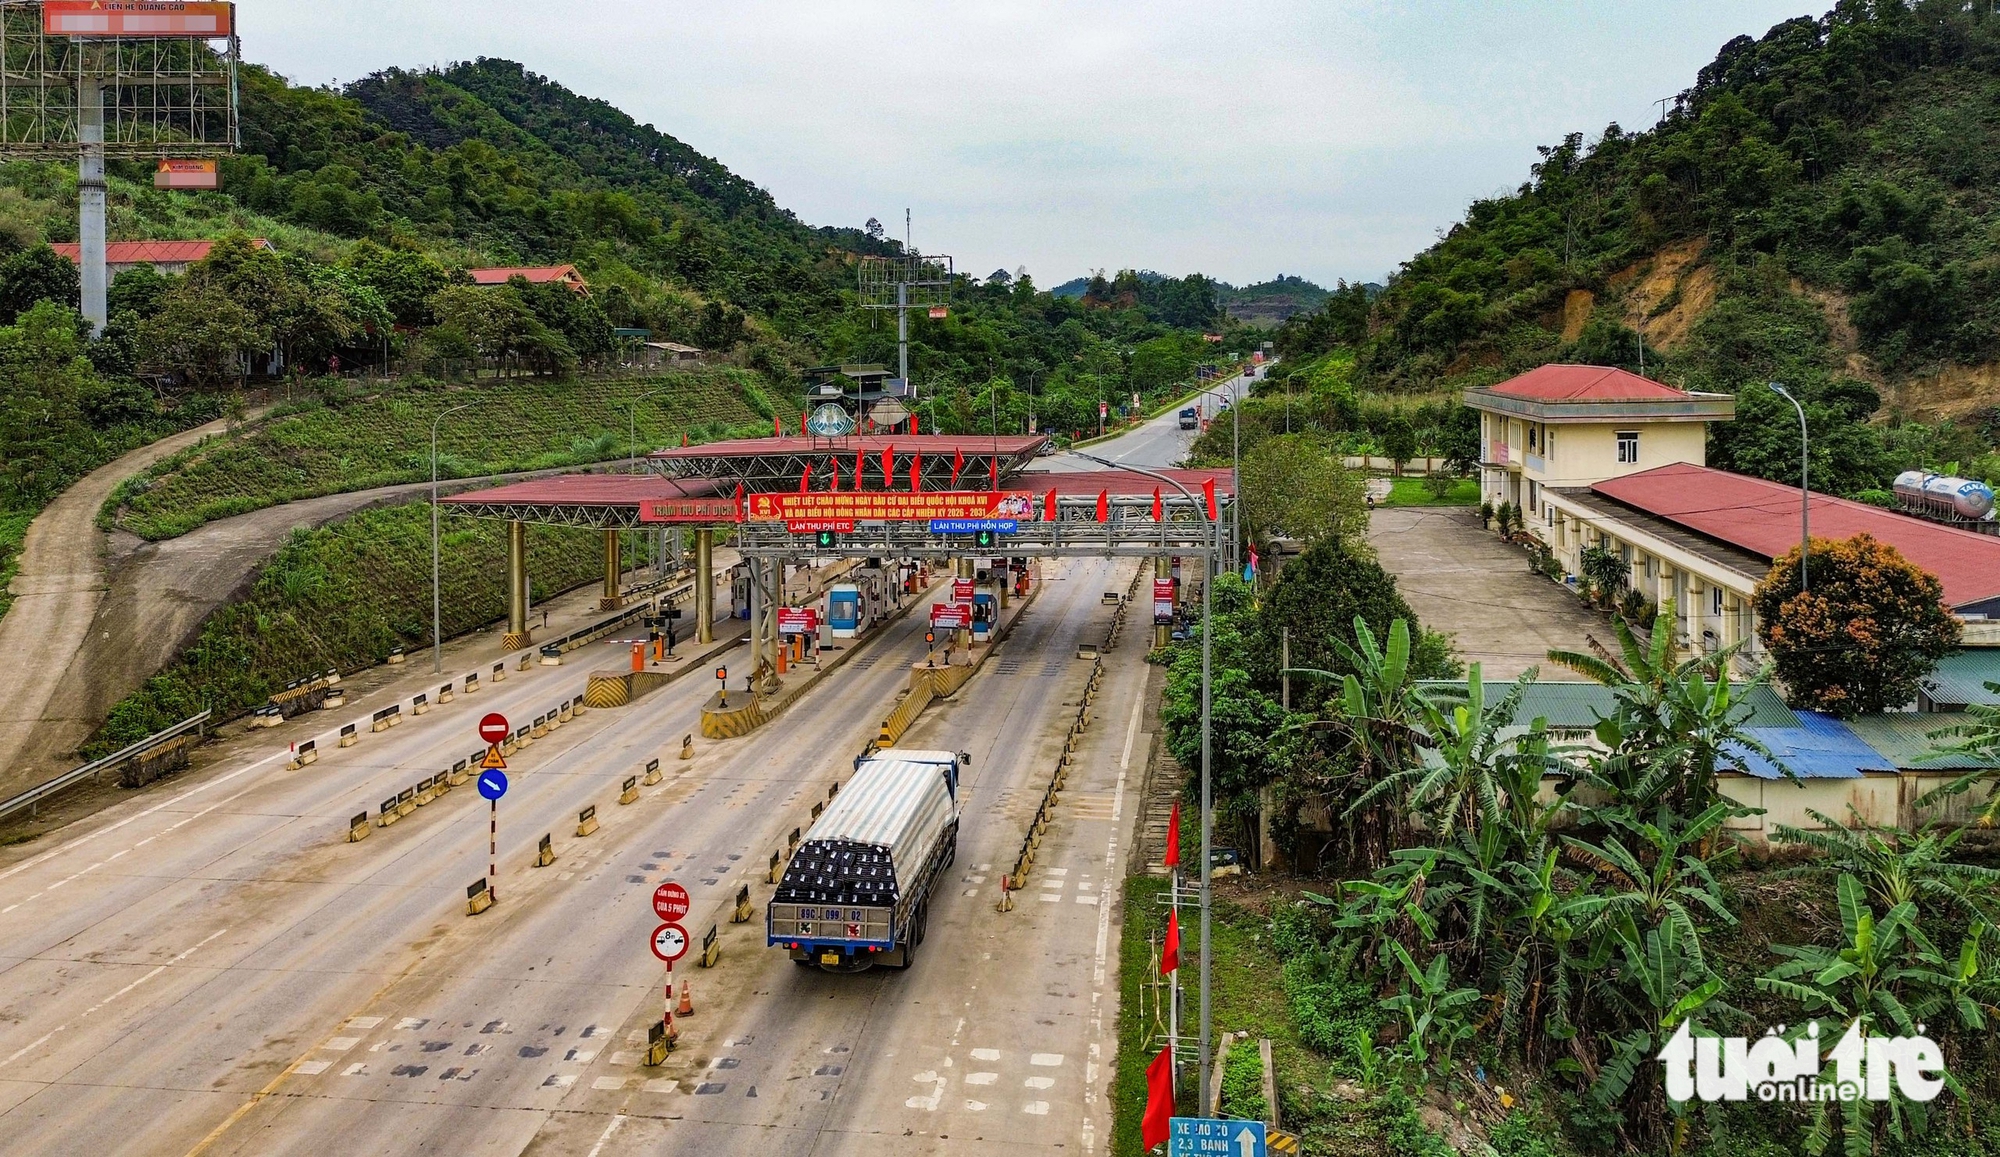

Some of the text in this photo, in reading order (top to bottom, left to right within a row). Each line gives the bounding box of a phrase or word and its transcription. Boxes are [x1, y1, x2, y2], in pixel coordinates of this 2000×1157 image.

[783, 496, 801, 507] NHIỆT
[802, 496, 815, 507] LIỆT
[816, 495, 834, 505] CHÀO
[834, 495, 854, 505] MỪNG
[855, 495, 871, 505] NGÀY
[873, 494, 885, 505] BẦU
[898, 496, 909, 506] ĐẠI
[910, 494, 925, 505] BIỂU
[926, 495, 944, 506] QUỐC
[945, 496, 956, 506] HỘI
[958, 495, 976, 505] KHOÁ
[977, 496, 988, 505] XVI
[785, 507, 793, 517] VÀ
[794, 508, 806, 519] ĐẠI
[807, 506, 822, 517] BIỂU
[823, 508, 835, 518] HỘI
[836, 507, 853, 517] ĐỒNG
[855, 507, 872, 517] NHÂN
[873, 507, 886, 517] DÂN
[887, 507, 900, 517] CÁC
[902, 506, 914, 517] CẤP
[916, 508, 936, 519] NHIỆM
[937, 507, 945, 517] KỲ
[947, 508, 964, 517] 2026
[970, 508, 986, 517] 2031
[790, 521, 805, 530] LÀN
[822, 521, 835, 530] PHÍ
[934, 521, 949, 530] LÀN
[967, 521, 979, 530] PHÍ
[981, 520, 997, 529] HỖN
[657, 888, 667, 897] CẤM
[668, 903, 672, 912] 5
[673, 903, 687, 914] PHÚT
[826, 910, 839, 919] 099
[852, 911, 860, 920] 02
[1177, 1122, 1190, 1135] XE
[1178, 1138, 1194, 1151] 2,3
